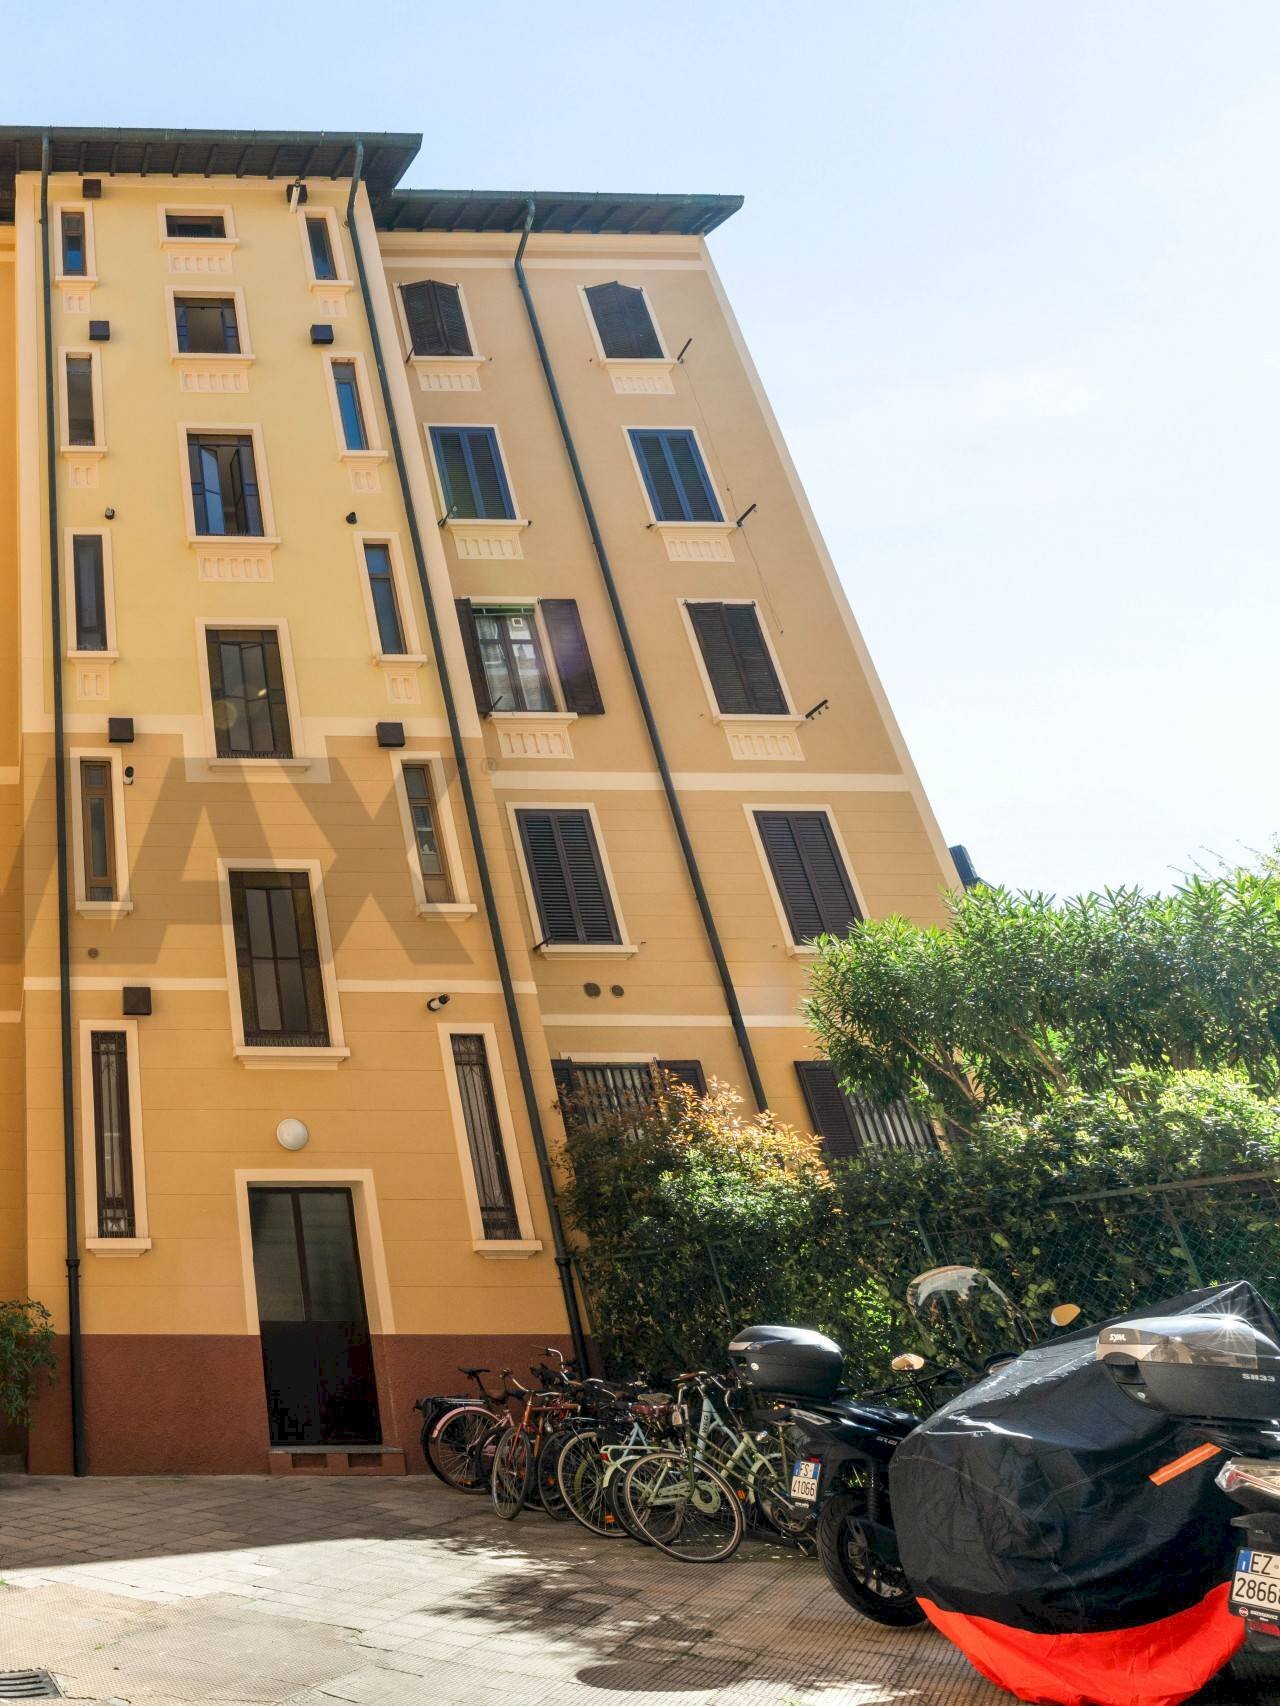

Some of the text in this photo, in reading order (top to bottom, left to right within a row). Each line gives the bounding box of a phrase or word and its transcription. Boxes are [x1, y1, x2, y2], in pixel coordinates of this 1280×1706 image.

[1109, 1333, 1127, 1343] SYM
[1250, 1553, 1273, 1575] EZ
[1235, 1578, 1280, 1604] 2866
